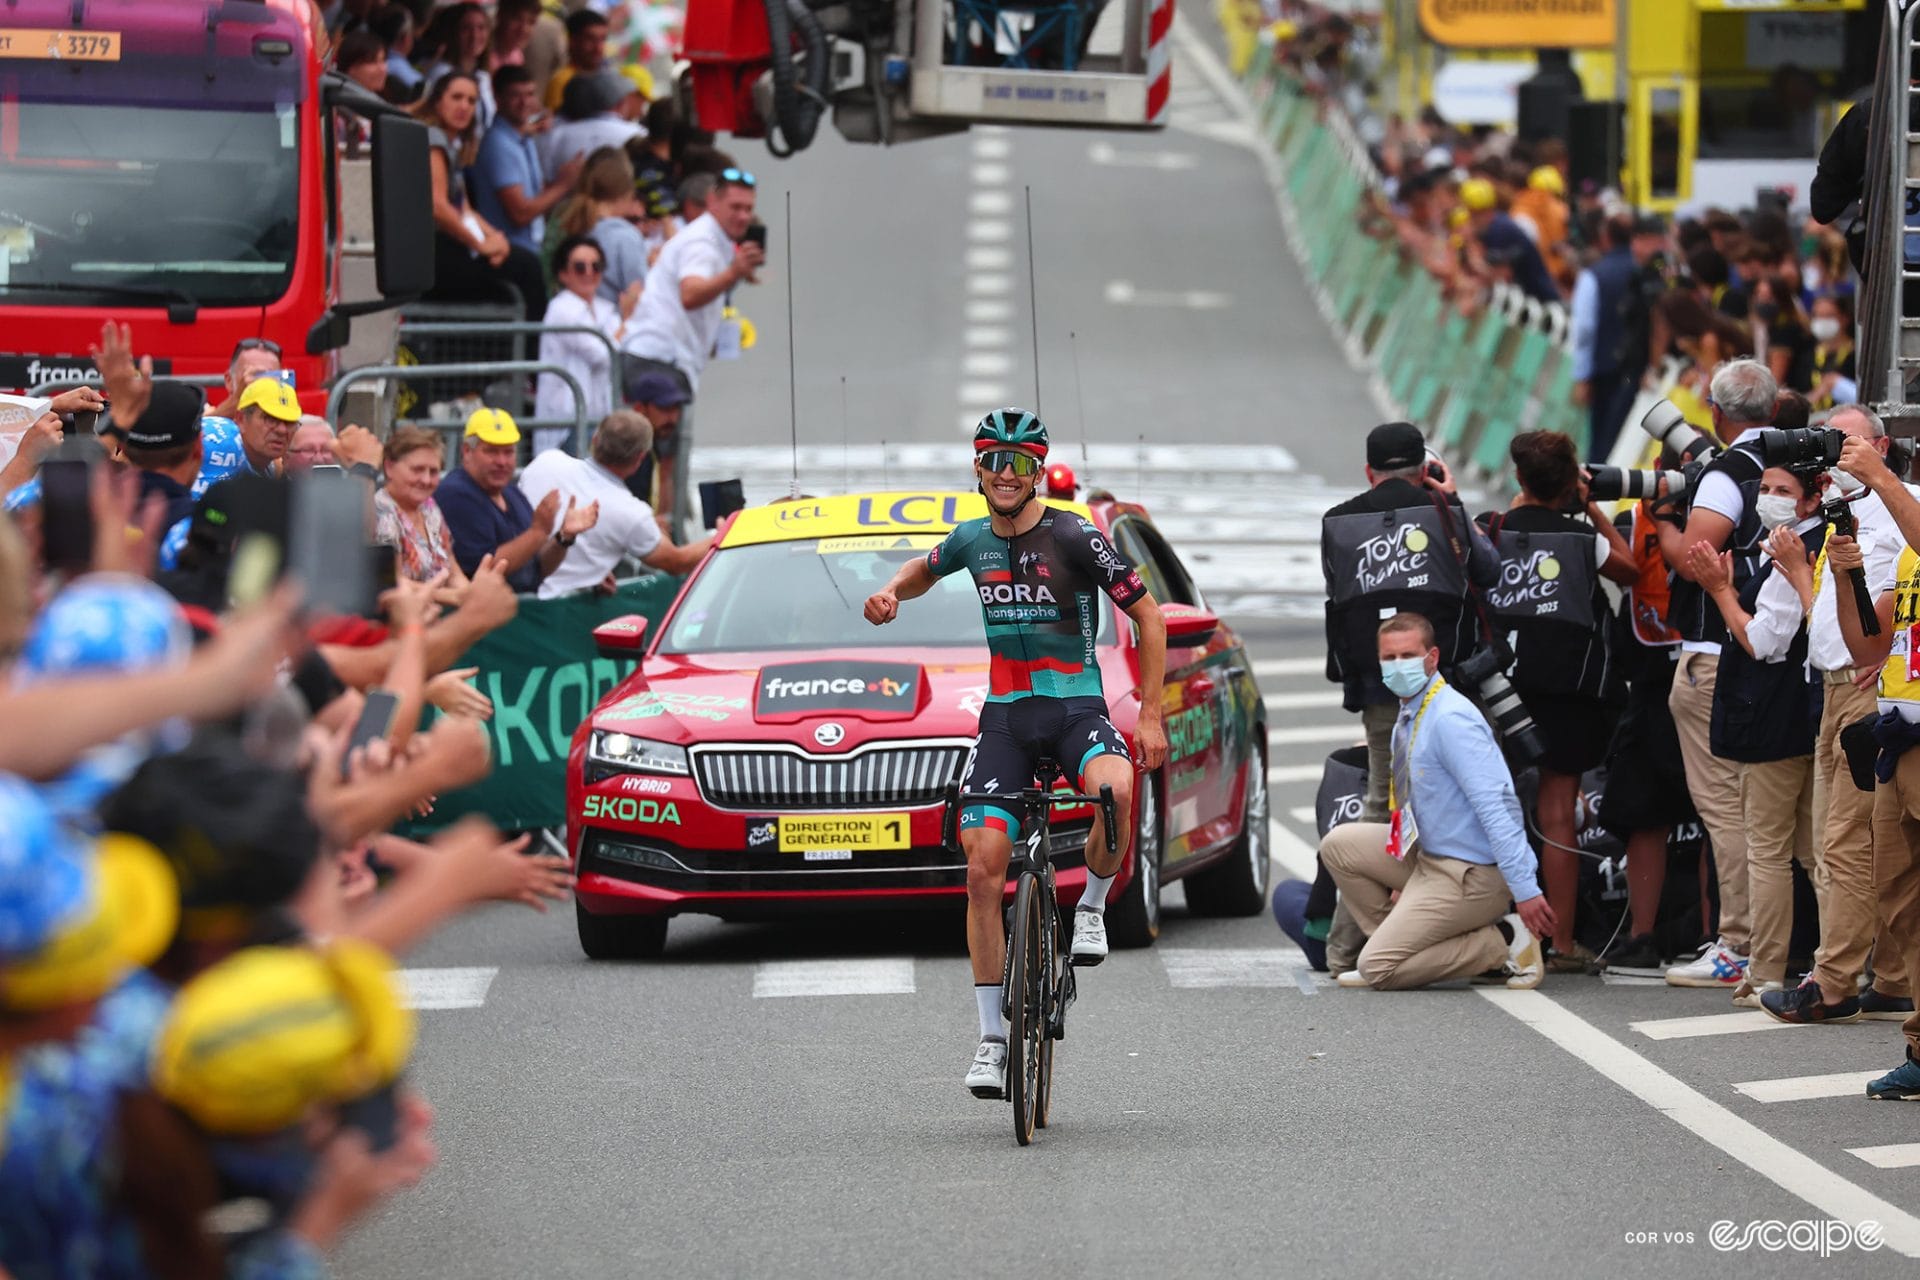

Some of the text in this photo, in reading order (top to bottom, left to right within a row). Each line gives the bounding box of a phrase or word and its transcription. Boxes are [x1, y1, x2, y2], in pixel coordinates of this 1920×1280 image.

[67, 35, 111, 55] 3379
[780, 506, 828, 521] LCL
[857, 496, 967, 526] LCL
[1407, 573, 1430, 588] 2023
[979, 583, 1057, 605] BORA
[986, 604, 1057, 620] hansgrohe
[1536, 600, 1559, 615] 2023
[1080, 594, 1095, 665] hansgrohe
[621, 777, 672, 794] HYBRID
[785, 821, 872, 833] DIRECTION
[884, 821, 901, 842] 1
